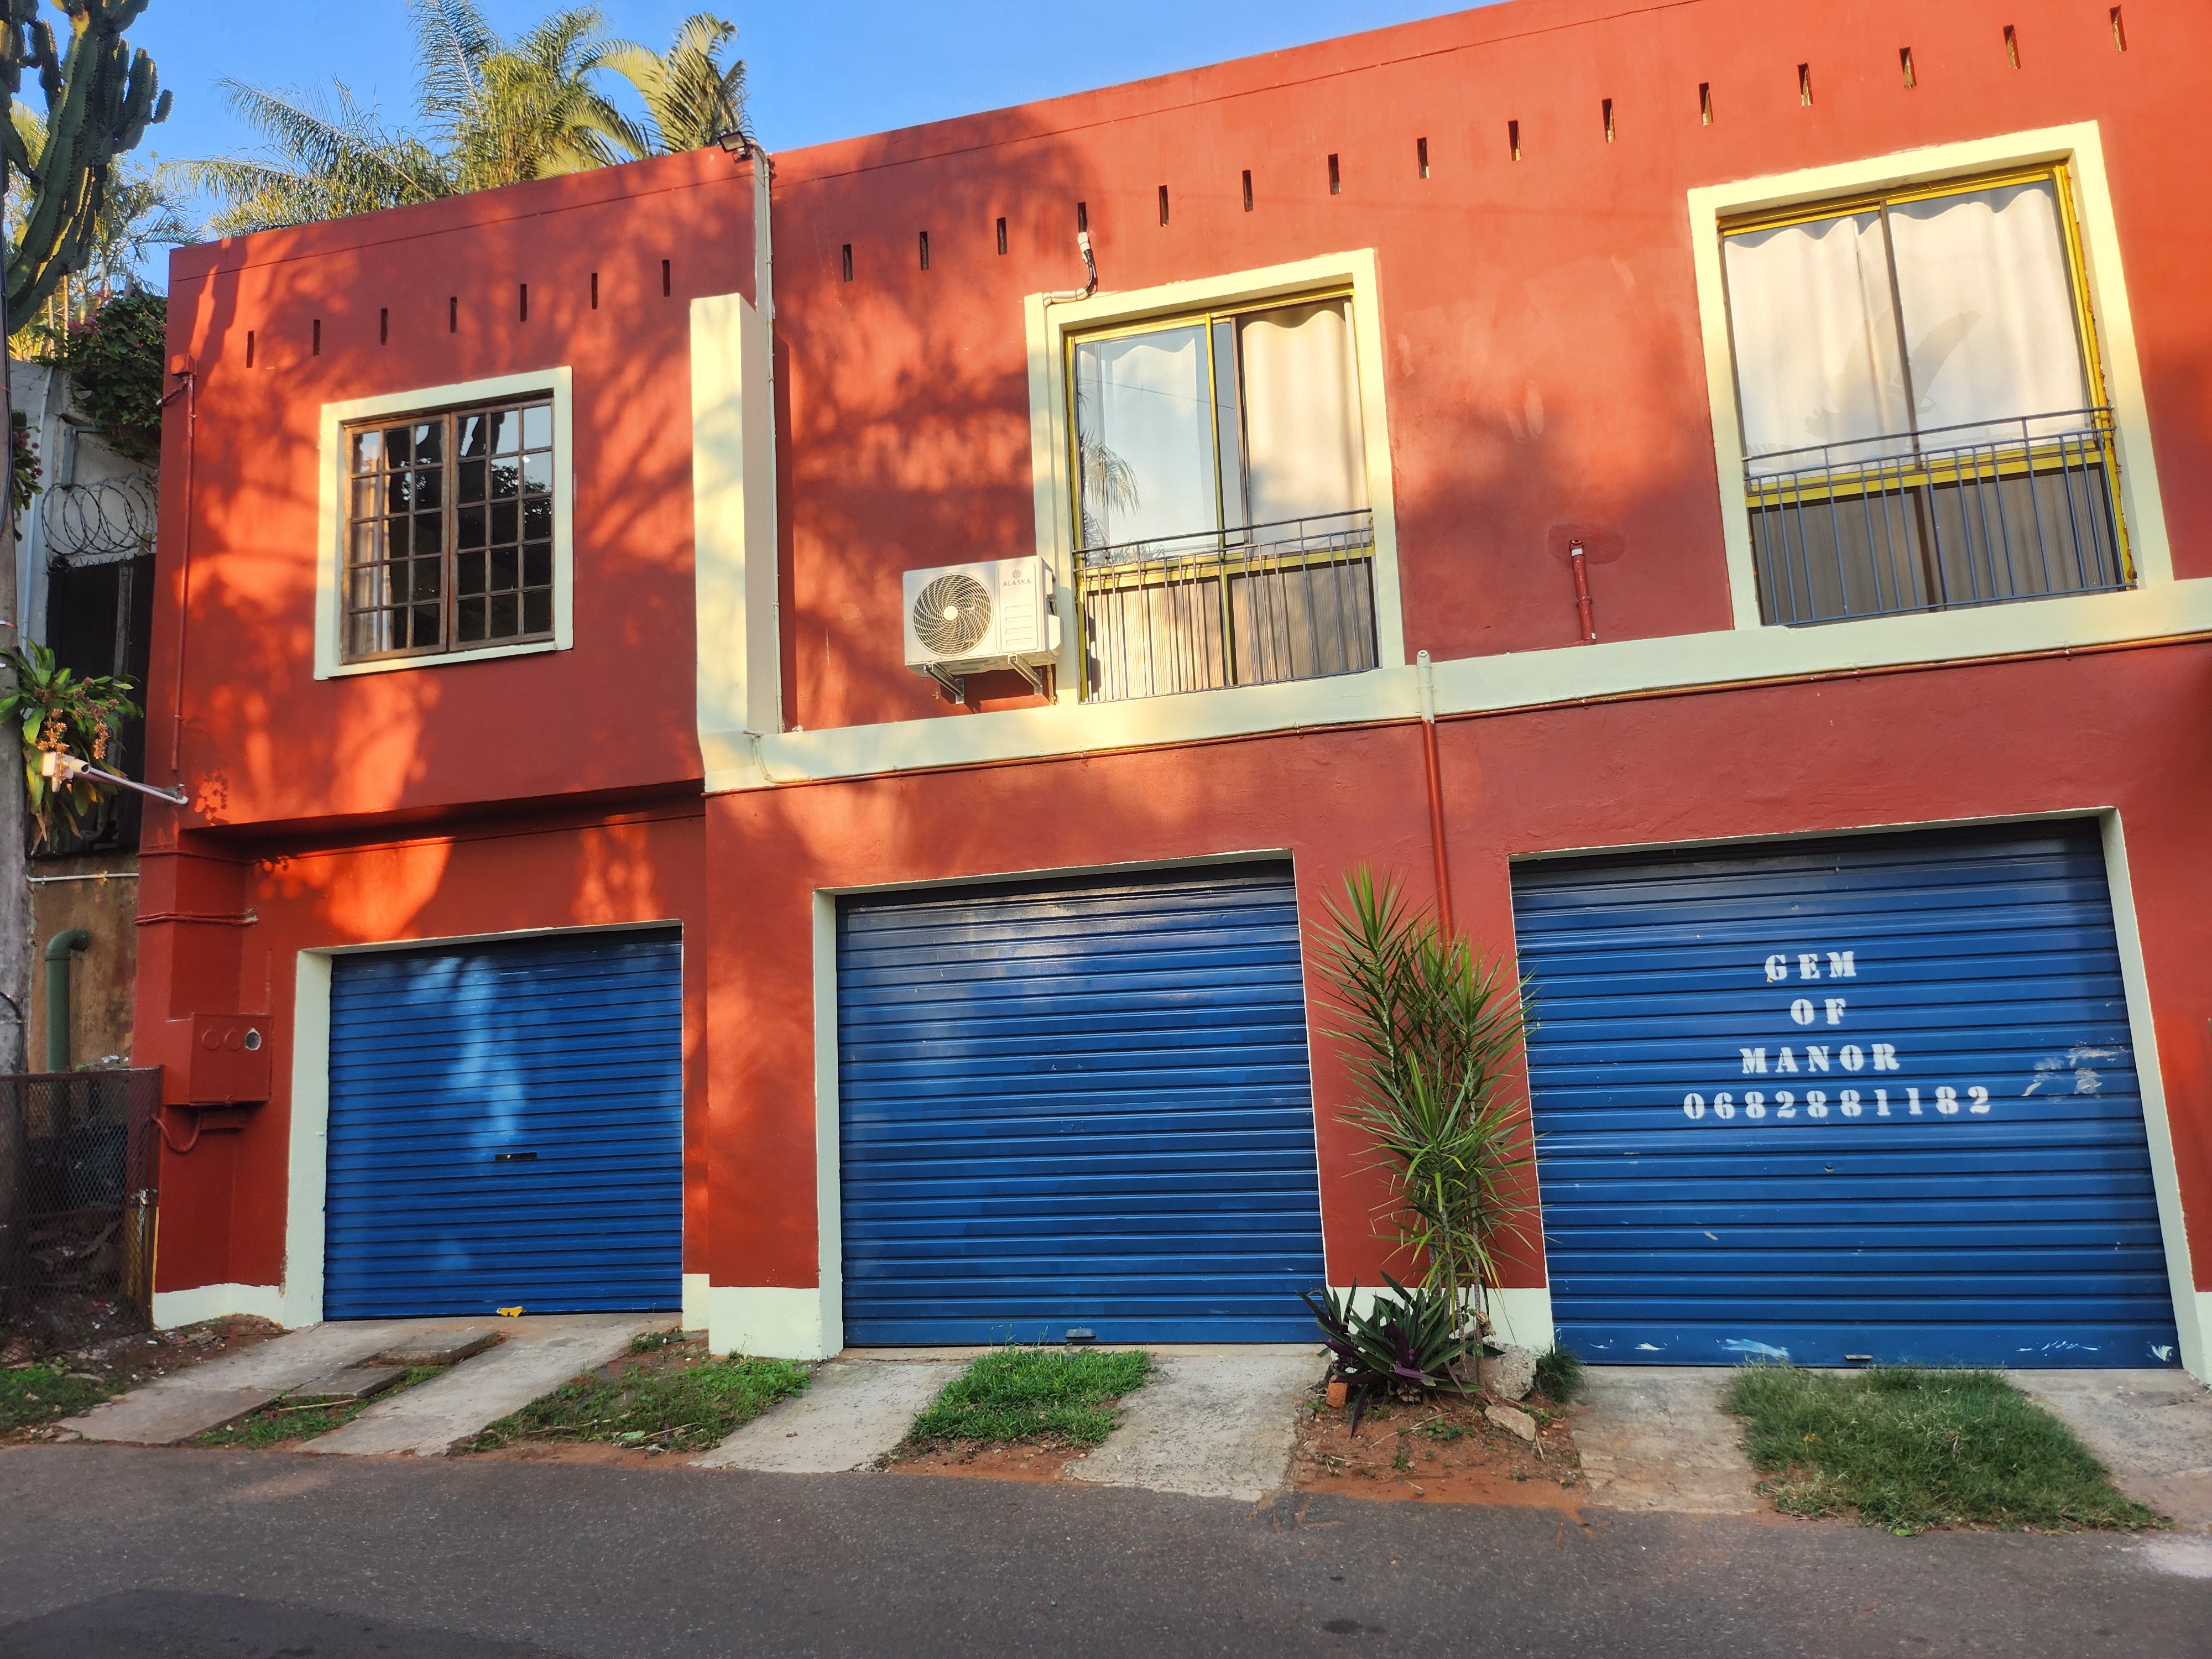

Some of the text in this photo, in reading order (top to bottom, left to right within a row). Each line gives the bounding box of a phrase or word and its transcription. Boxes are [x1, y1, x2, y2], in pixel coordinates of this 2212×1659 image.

[1764, 951, 1856, 981] GEM
[1790, 998, 1846, 1025] OF
[1739, 1044, 1900, 1074] MANOR
[1683, 1086, 1990, 1120] 0682881182
